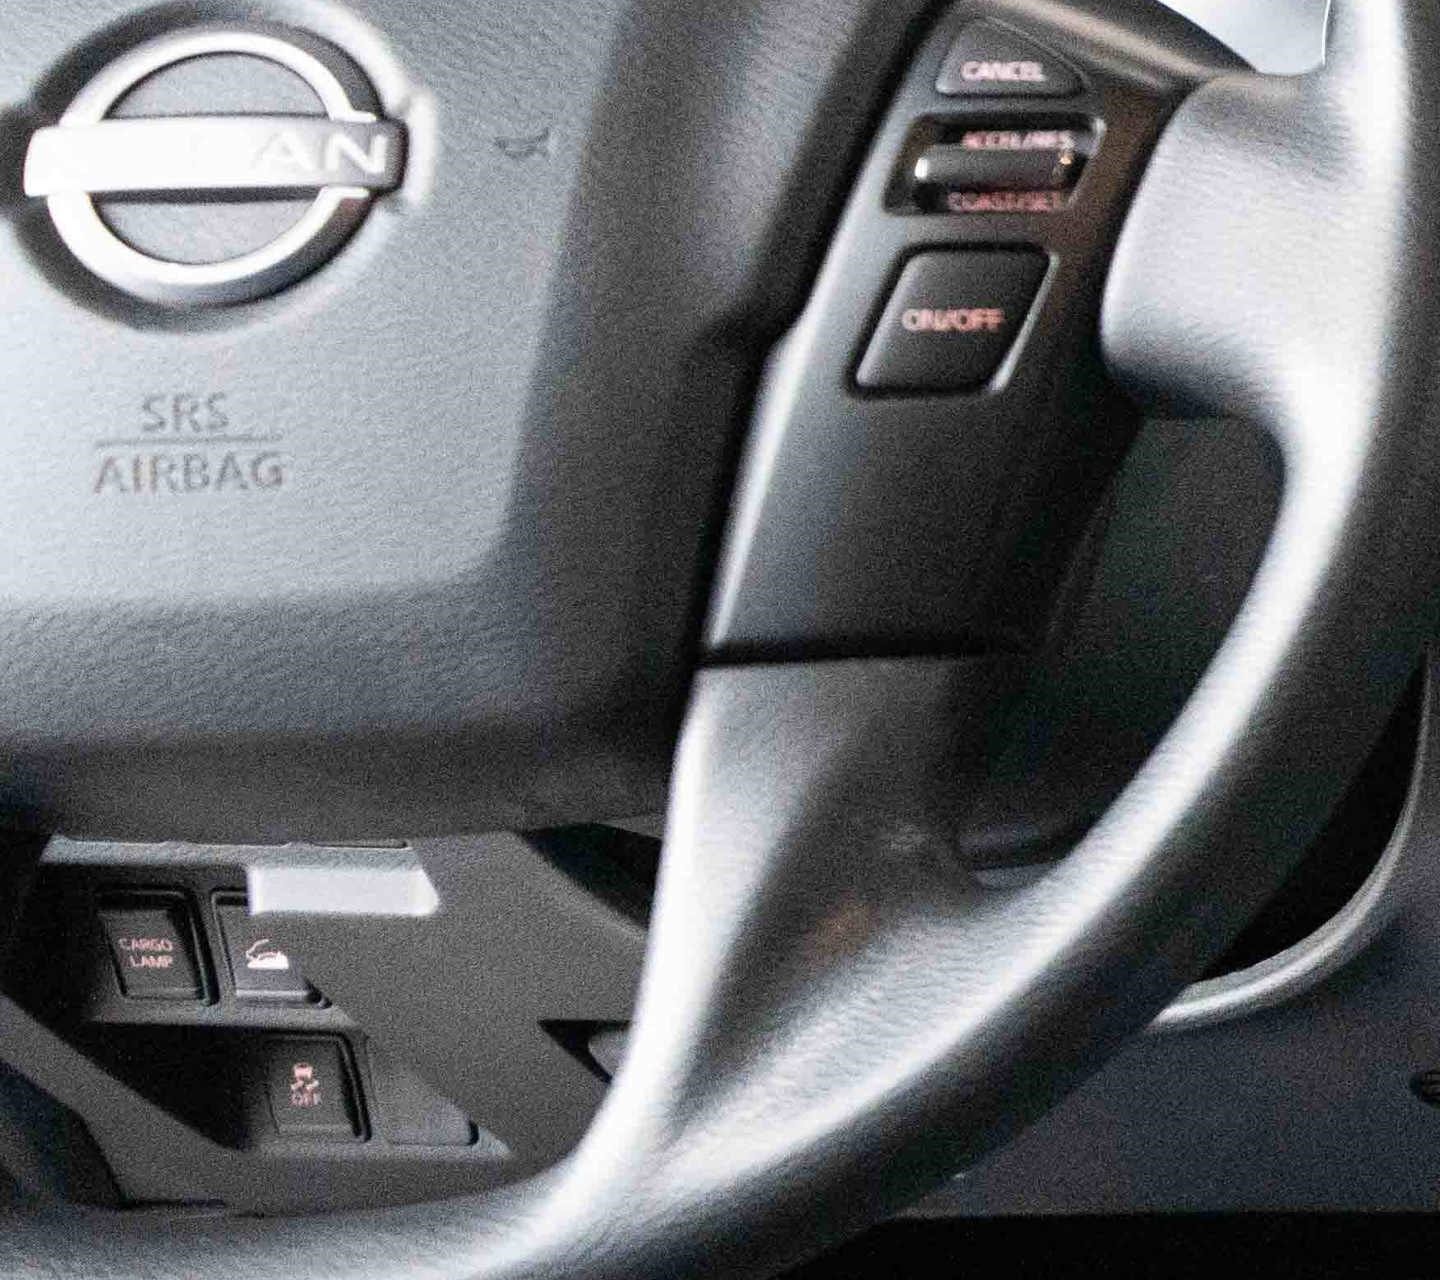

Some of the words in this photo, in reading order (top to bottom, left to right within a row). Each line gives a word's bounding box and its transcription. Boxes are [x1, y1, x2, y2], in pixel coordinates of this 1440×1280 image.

[961, 61, 1045, 81] CANCEL
[902, 308, 1005, 332] ON/OFF
[140, 391, 230, 433] SRS
[92, 450, 284, 495] AIRBAG
[118, 938, 174, 952] CARGO
[129, 954, 174, 969] LAMP
